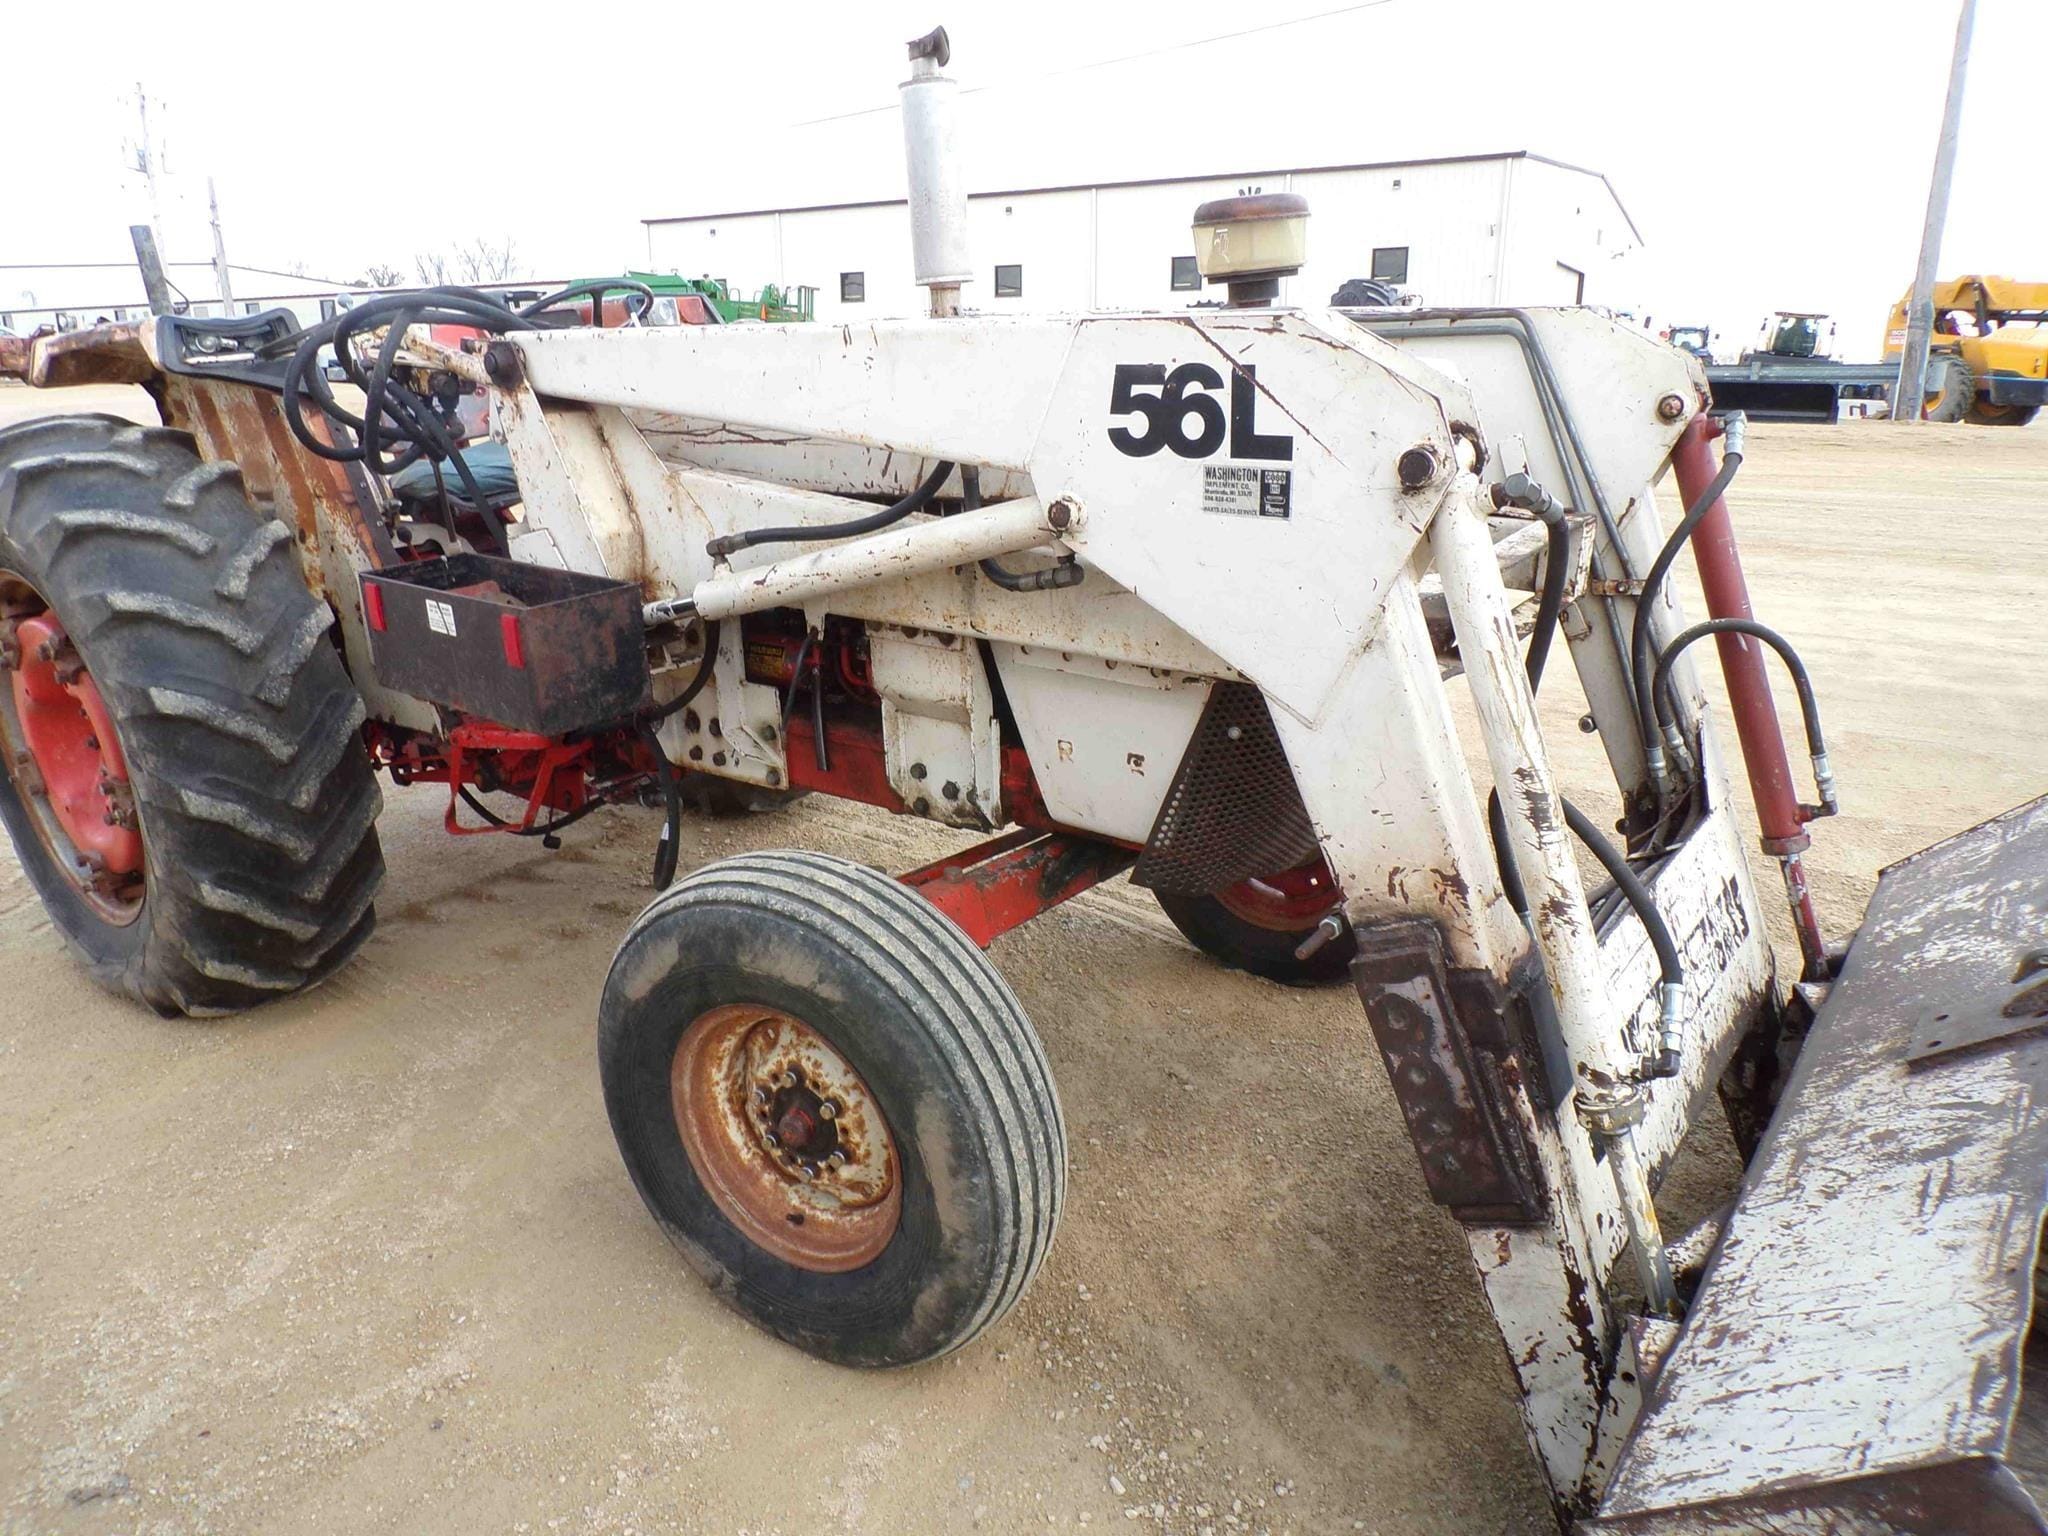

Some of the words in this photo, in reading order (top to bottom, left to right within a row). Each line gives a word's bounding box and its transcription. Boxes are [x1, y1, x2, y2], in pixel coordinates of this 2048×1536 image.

[1107, 362, 1294, 461] 56L
[1204, 466, 1259, 483] WASHINGTON
[1204, 480, 1239, 489] IMPLEMENT
